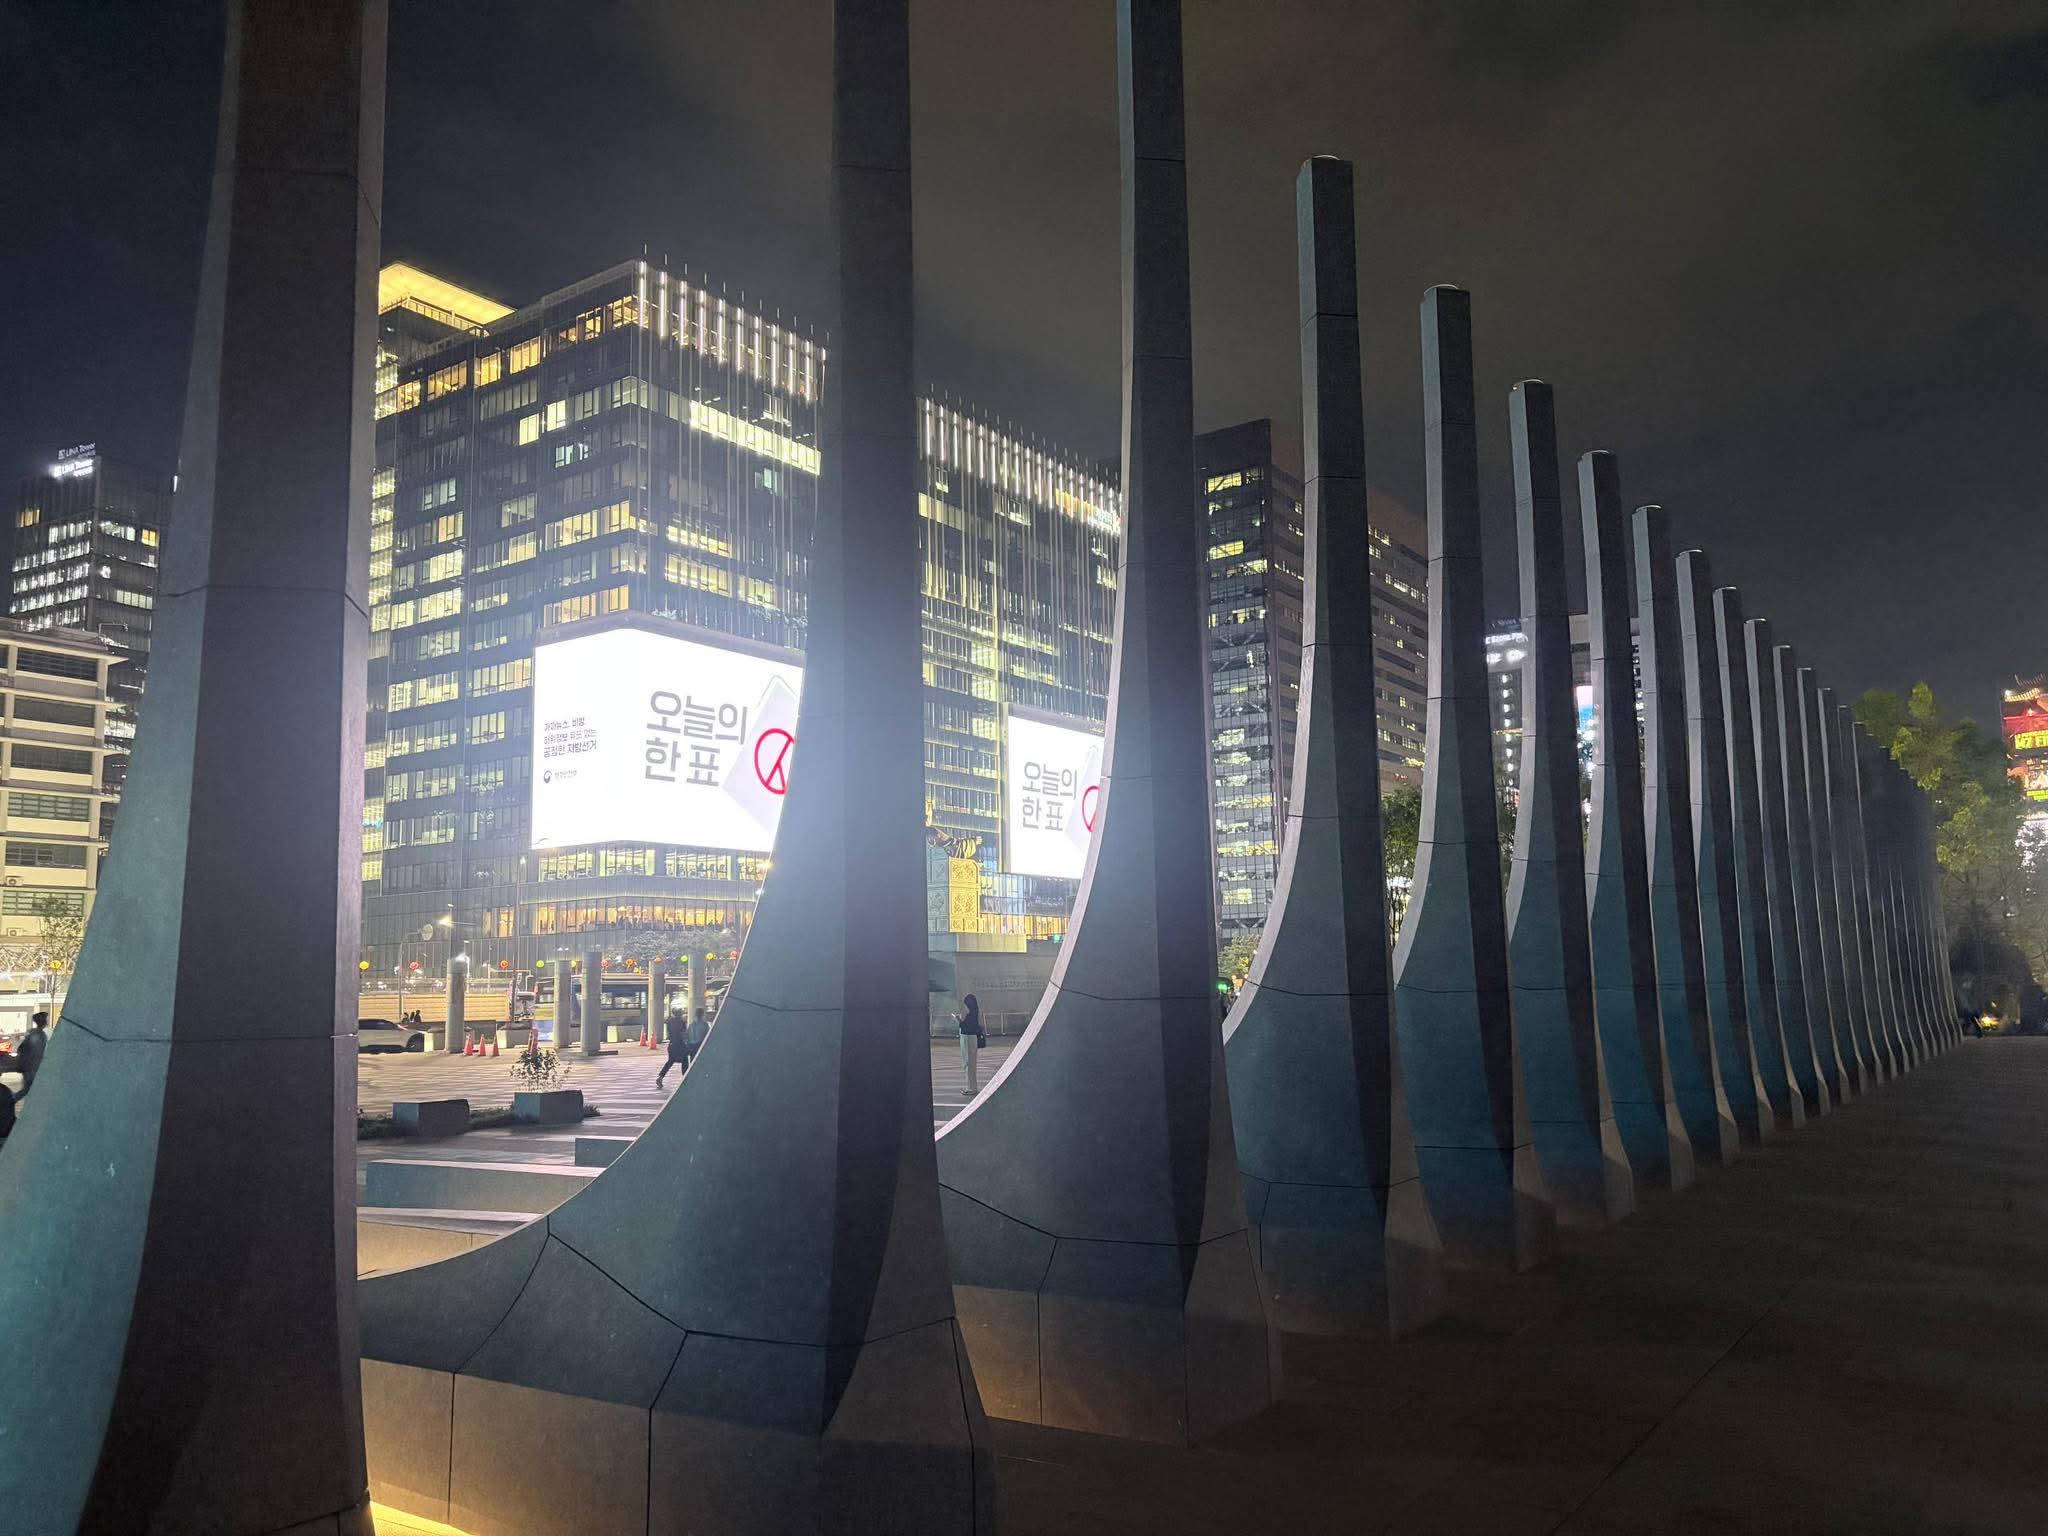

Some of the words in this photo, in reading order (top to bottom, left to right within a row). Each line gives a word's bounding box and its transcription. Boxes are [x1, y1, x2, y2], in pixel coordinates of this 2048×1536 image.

[646, 690, 748, 745] 오늘의
[567, 739, 597, 754] 지방선거
[645, 737, 682, 783] 한
[686, 744, 721, 787] 표
[1022, 761, 1078, 800] 오늘의
[1022, 796, 1042, 830] 한
[1045, 800, 1063, 832] 표
